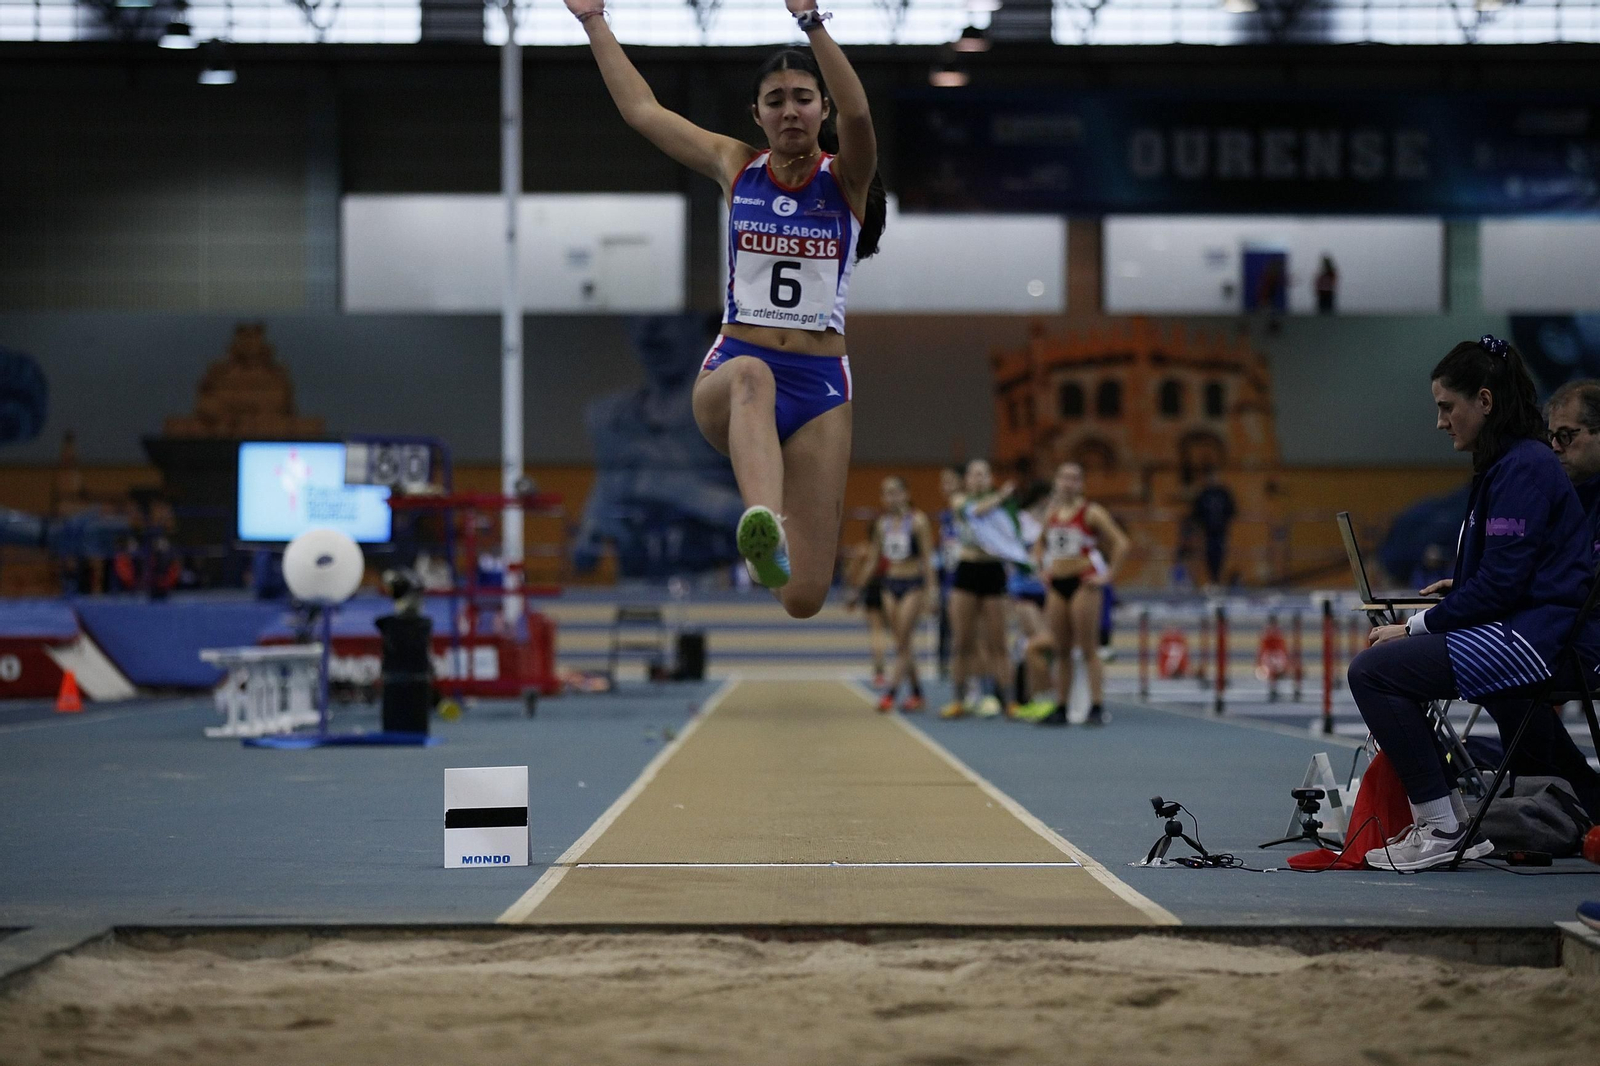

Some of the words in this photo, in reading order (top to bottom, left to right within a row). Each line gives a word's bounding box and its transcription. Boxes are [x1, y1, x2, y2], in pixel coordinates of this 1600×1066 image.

[1127, 128, 1430, 180] OURENSE
[734, 220, 777, 234] NEXUS
[782, 225, 832, 239] SABON
[741, 233, 800, 254] CLUBS
[804, 240, 837, 257] S16
[769, 260, 802, 309] 6
[752, 308, 818, 325] atletismo.gal
[461, 855, 511, 864] MONDO
